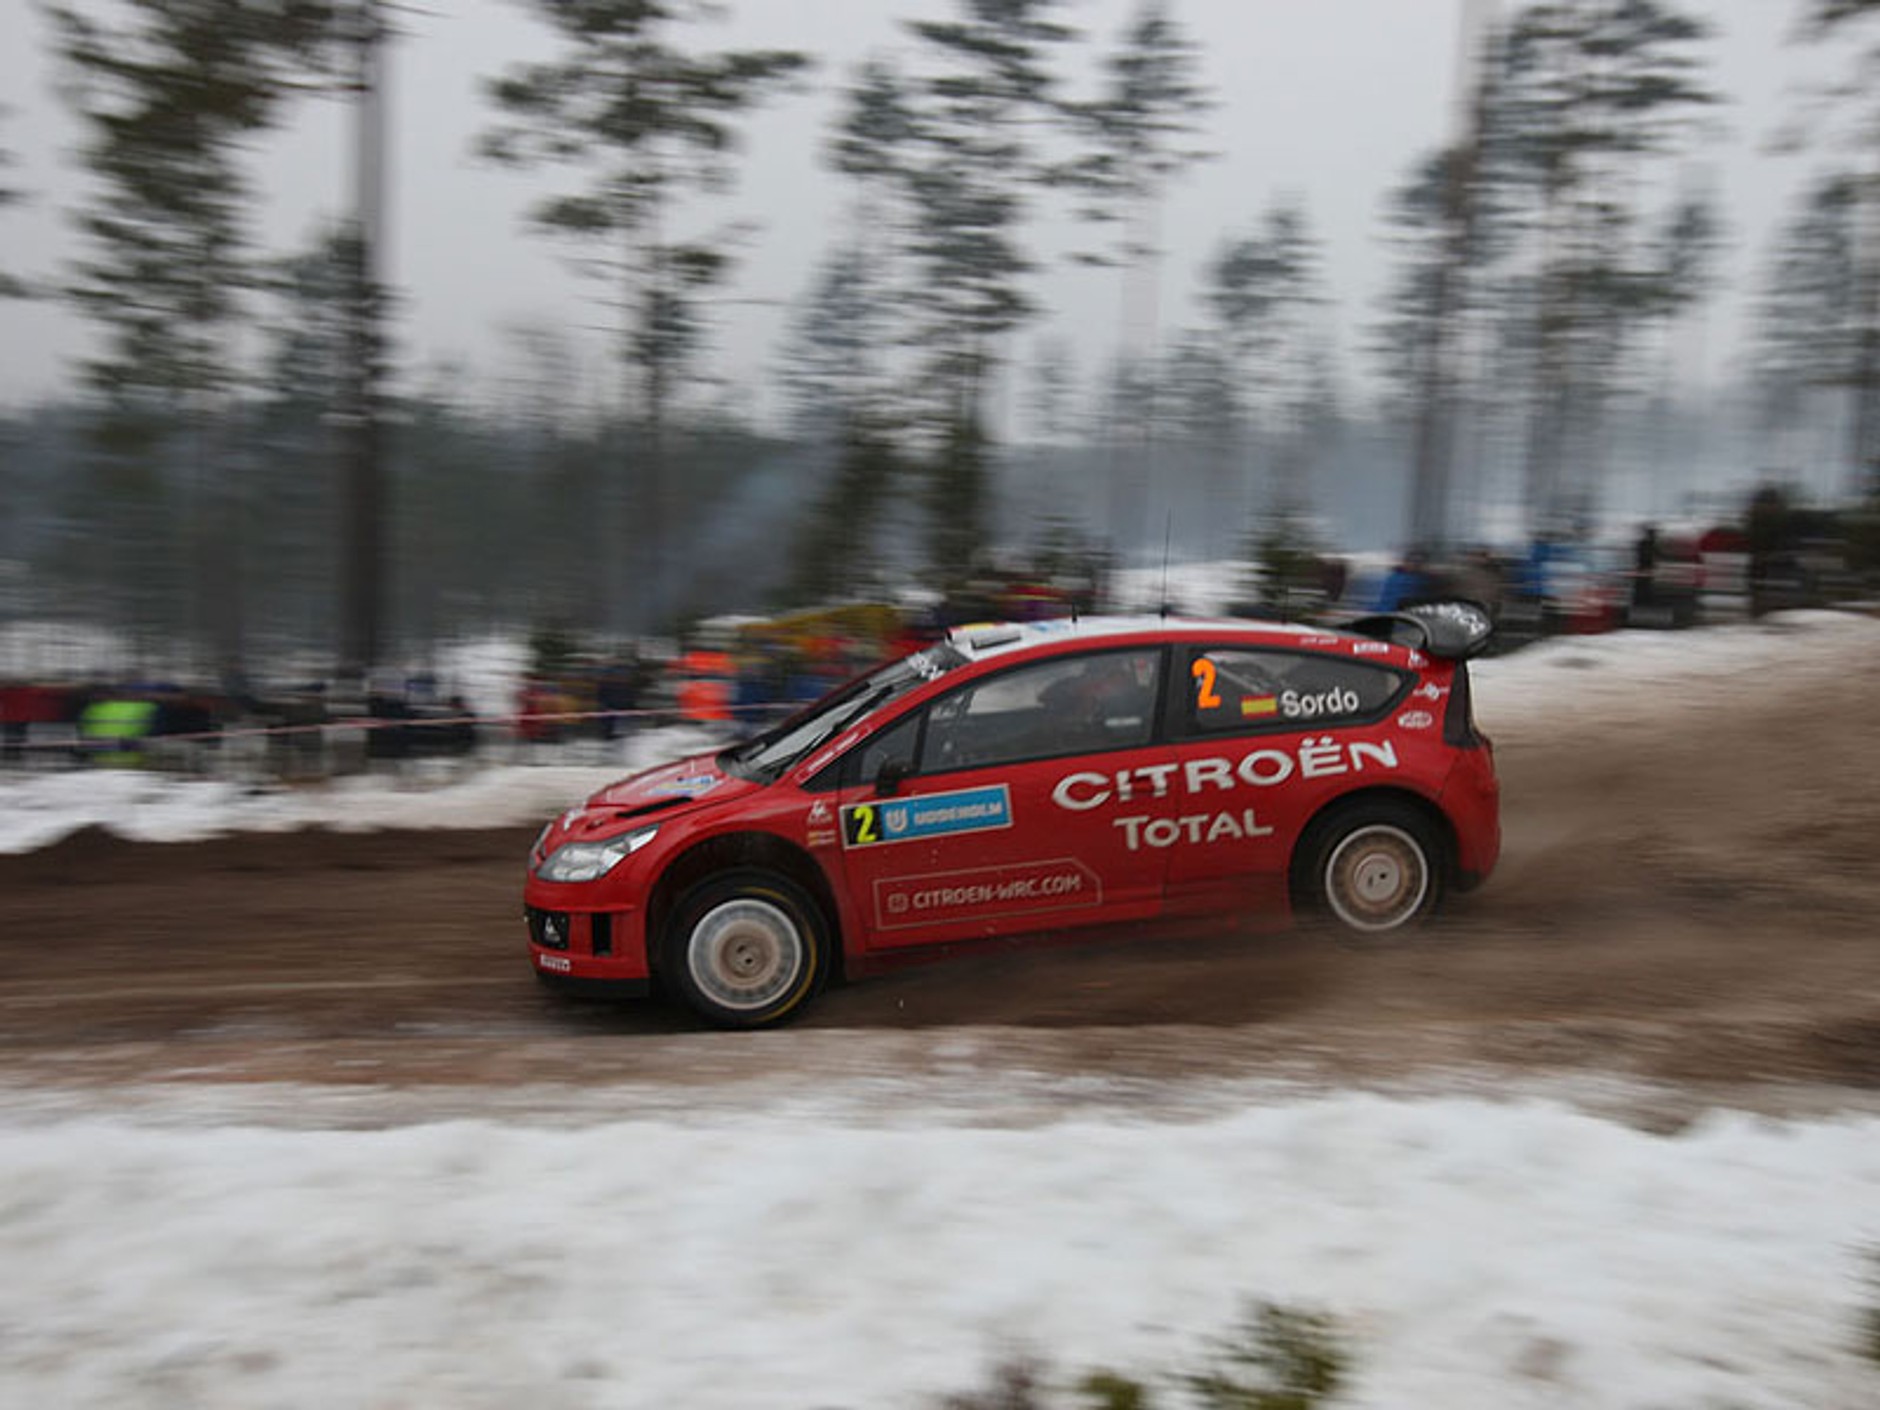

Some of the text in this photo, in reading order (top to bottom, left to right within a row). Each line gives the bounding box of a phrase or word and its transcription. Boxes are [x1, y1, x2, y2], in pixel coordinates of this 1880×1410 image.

[1191, 657, 1222, 709] 2
[1281, 685, 1360, 718] Sordo
[1051, 736, 1398, 811] CITROËN
[853, 805, 877, 843] 2
[1112, 808, 1275, 851] TOTAL
[912, 874, 1082, 909] CITROEN-WRC.COM
